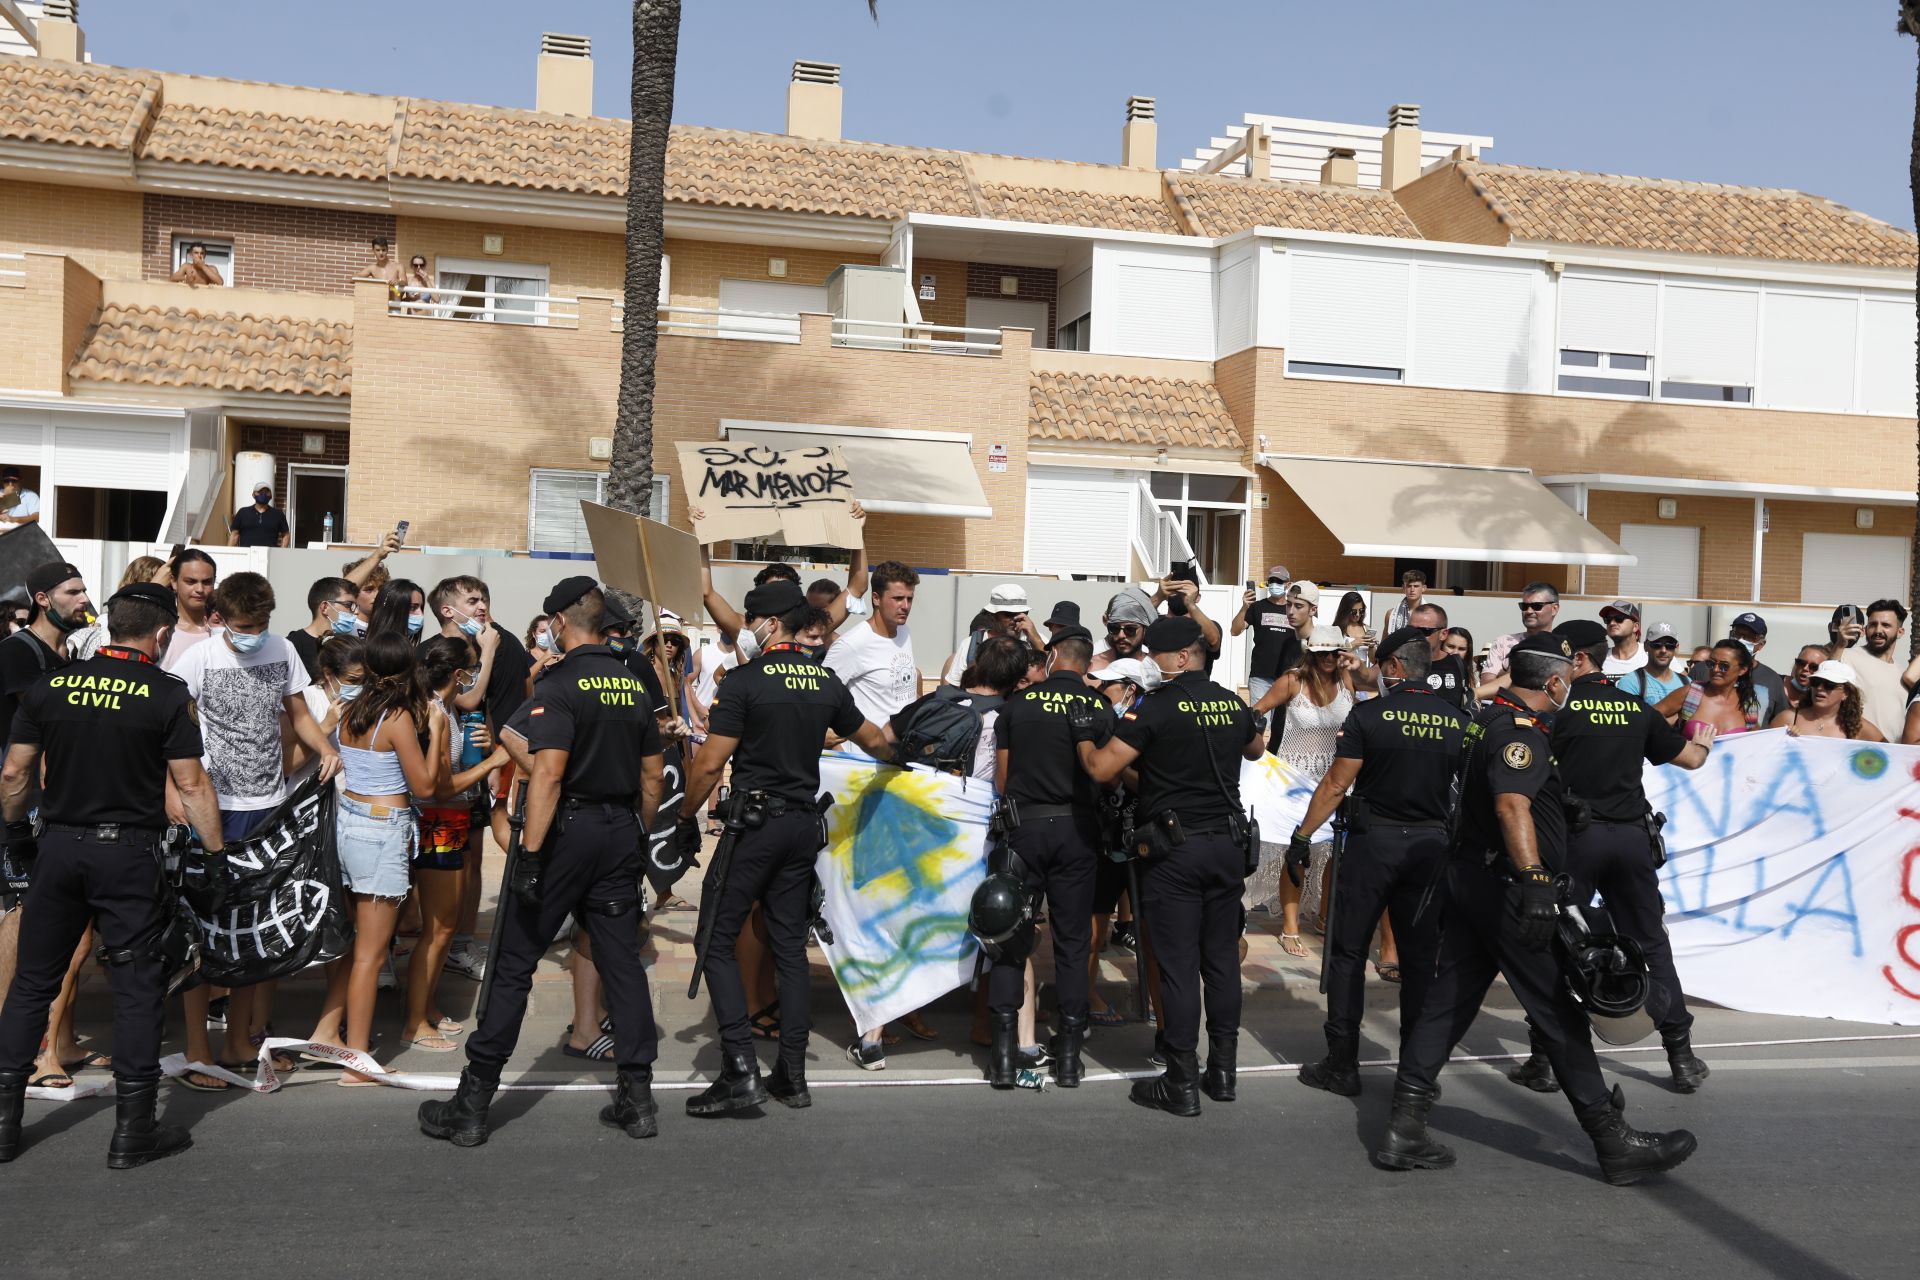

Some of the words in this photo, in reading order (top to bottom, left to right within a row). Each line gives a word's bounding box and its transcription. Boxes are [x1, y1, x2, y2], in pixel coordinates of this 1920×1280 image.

[699, 466, 750, 499] MAR
[756, 463, 853, 500] MENOR
[762, 664, 830, 678] GUARDIA
[49, 675, 150, 698] GUARDIA
[578, 676, 645, 694] GUARDIA
[785, 676, 820, 691] CIVIL
[67, 691, 121, 710] CIVIL
[600, 692, 635, 706] CIVIL
[1569, 699, 1642, 713] GUARDIA
[1382, 710, 1461, 730] GUARDIA
[1589, 712, 1629, 725] CIVIL
[1401, 724, 1444, 740] CIVIL
[308, 1042, 358, 1065] CARRETERA
